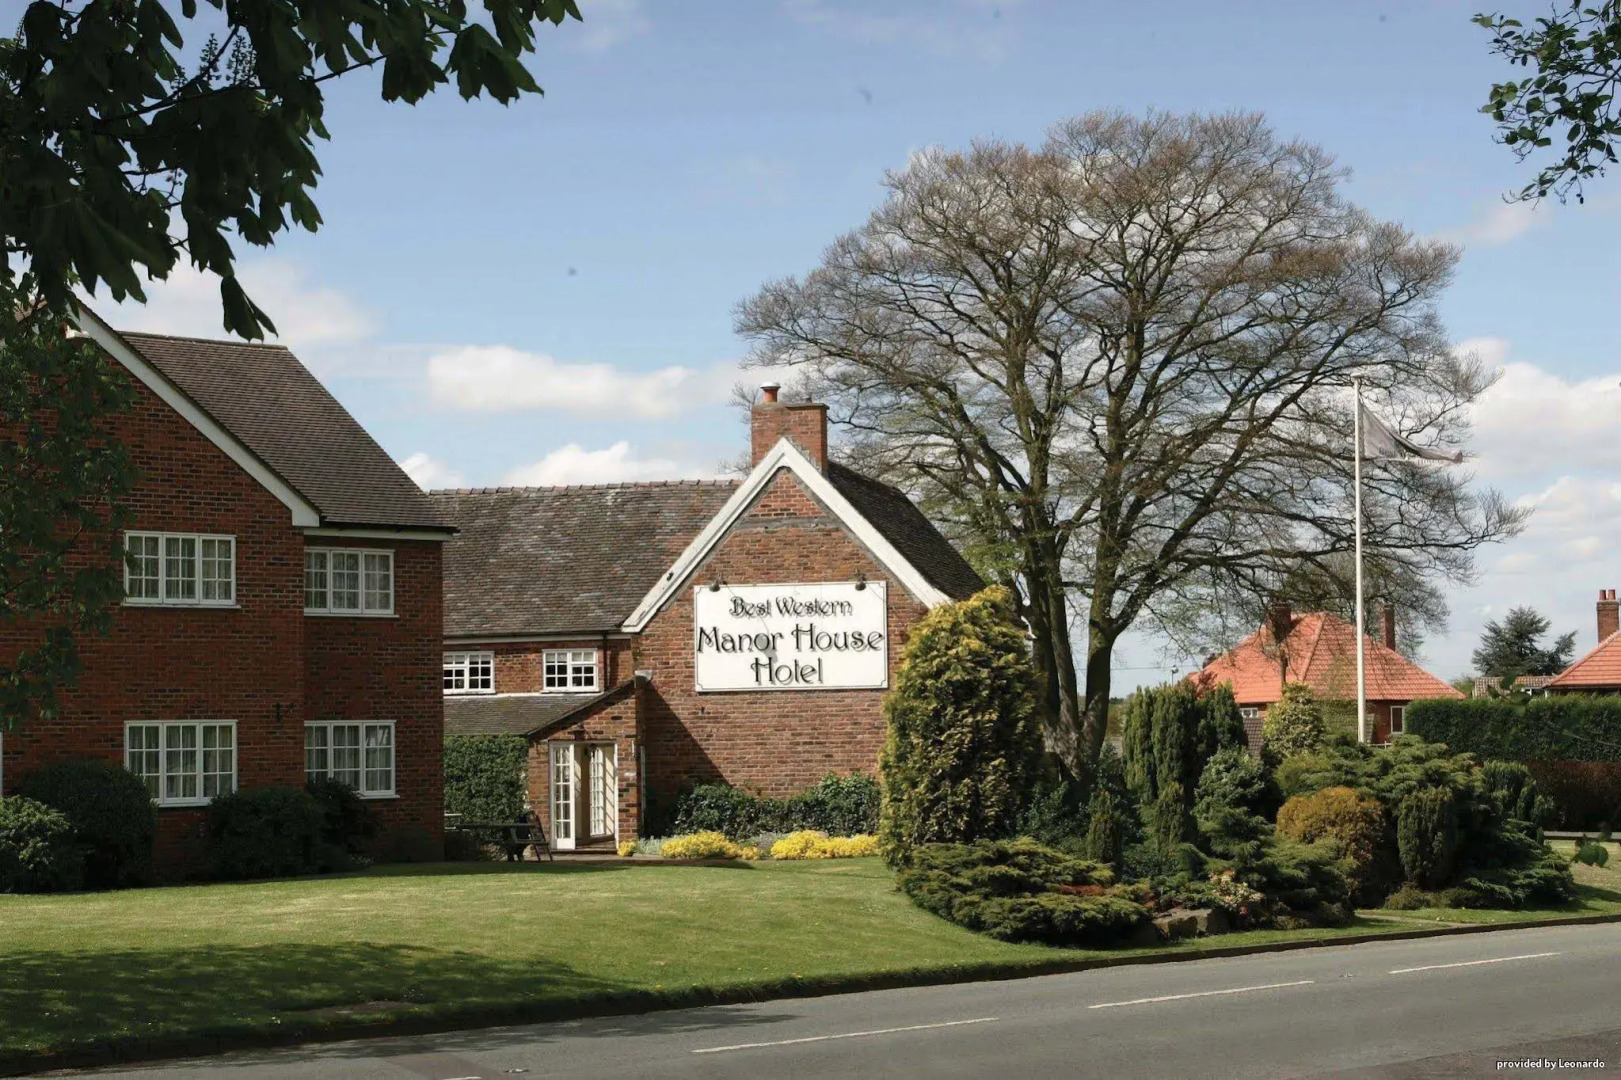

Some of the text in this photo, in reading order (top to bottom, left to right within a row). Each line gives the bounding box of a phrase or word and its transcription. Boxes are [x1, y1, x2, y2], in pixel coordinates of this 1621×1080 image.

[729, 596, 853, 617] Best Western
[697, 623, 885, 653] Manor House
[750, 657, 824, 686] Hotel
